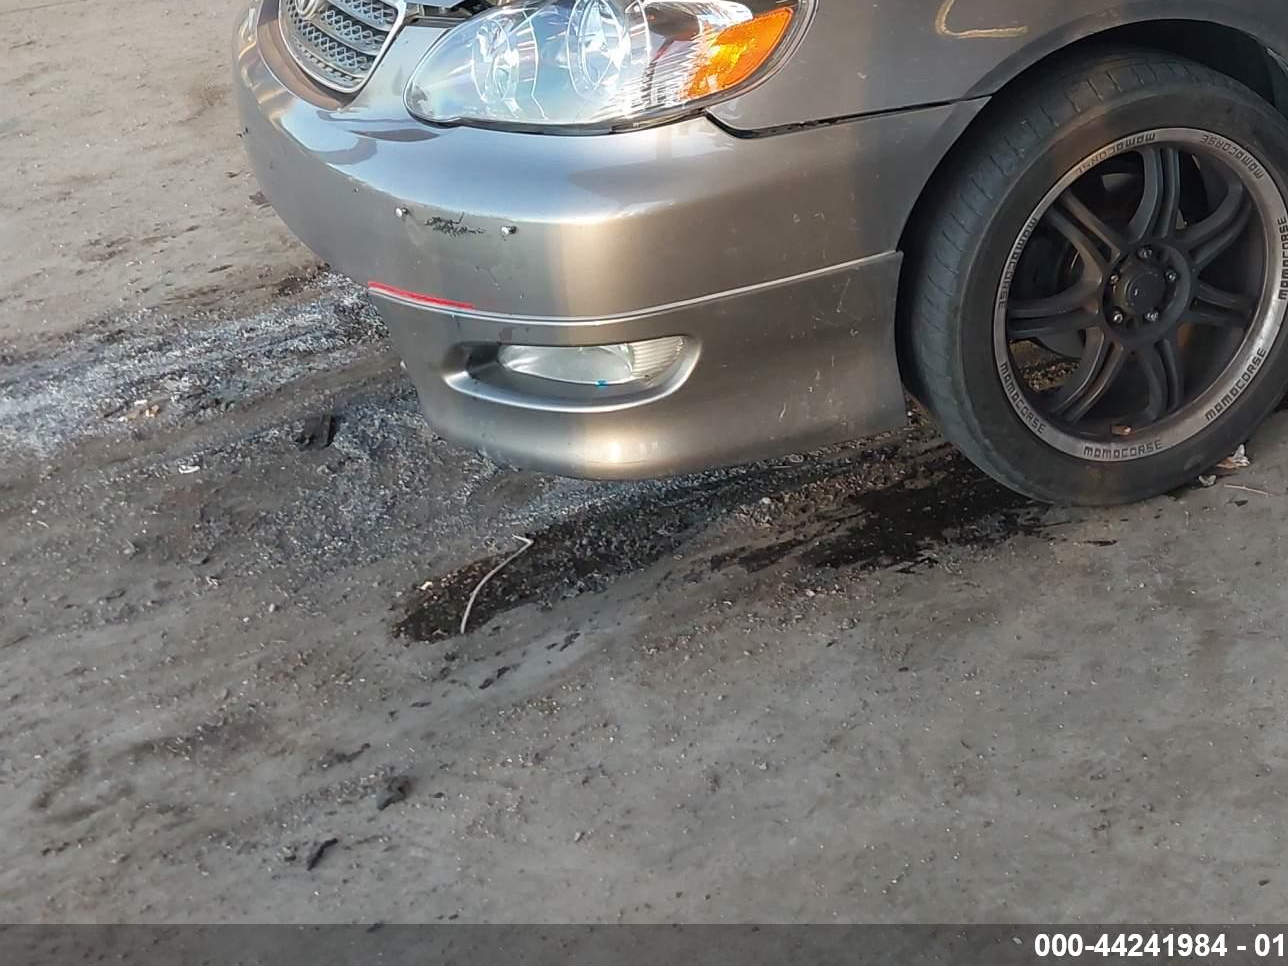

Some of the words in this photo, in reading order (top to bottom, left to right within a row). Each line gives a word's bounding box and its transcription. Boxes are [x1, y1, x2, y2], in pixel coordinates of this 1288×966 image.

[1000, 362, 1048, 435] MOMOCORSE
[1204, 346, 1267, 422] MOMOCORSE
[1083, 439, 1163, 459] MOMOCORSE
